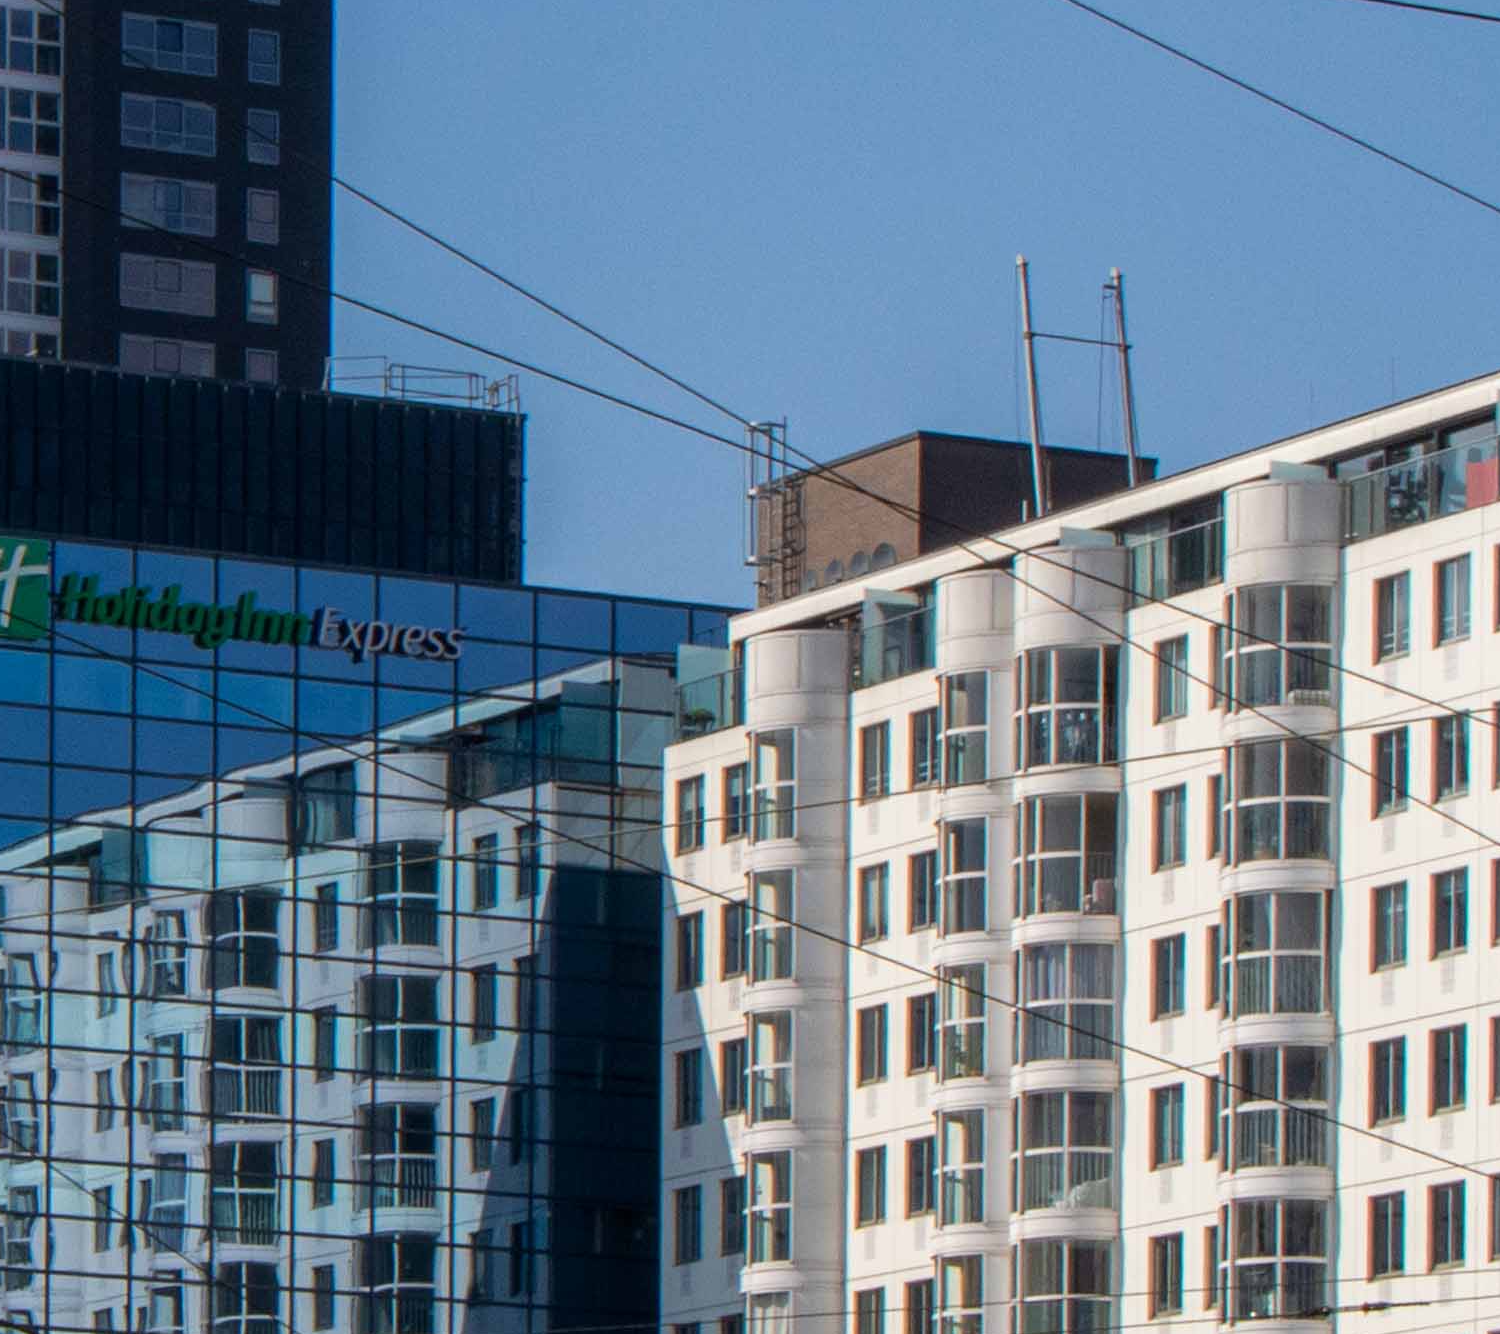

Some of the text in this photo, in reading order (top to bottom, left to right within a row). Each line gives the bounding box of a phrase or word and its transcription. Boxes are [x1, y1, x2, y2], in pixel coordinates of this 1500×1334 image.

[56, 572, 466, 664] Holiday Inn Express
